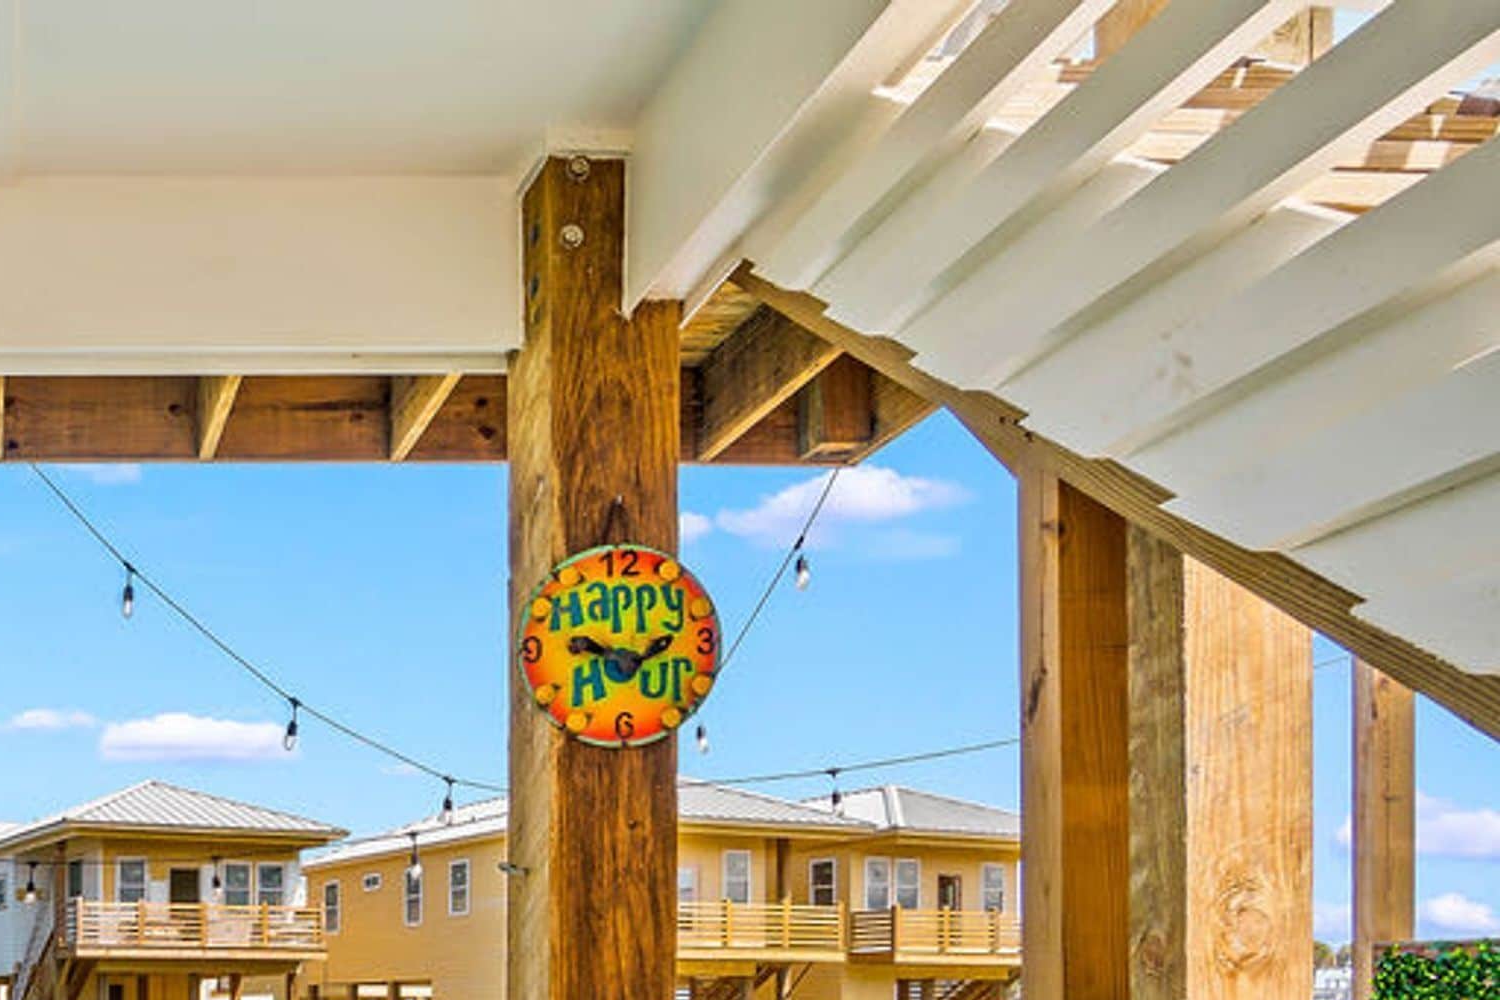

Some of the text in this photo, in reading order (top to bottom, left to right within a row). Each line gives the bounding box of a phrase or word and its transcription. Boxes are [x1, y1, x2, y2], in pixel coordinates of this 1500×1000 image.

[599, 550, 640, 577] 12
[549, 582, 685, 634] Happy
[521, 636, 542, 662] 9
[697, 628, 715, 655] 3
[572, 652, 693, 707] Hour
[614, 712, 634, 738] 6
